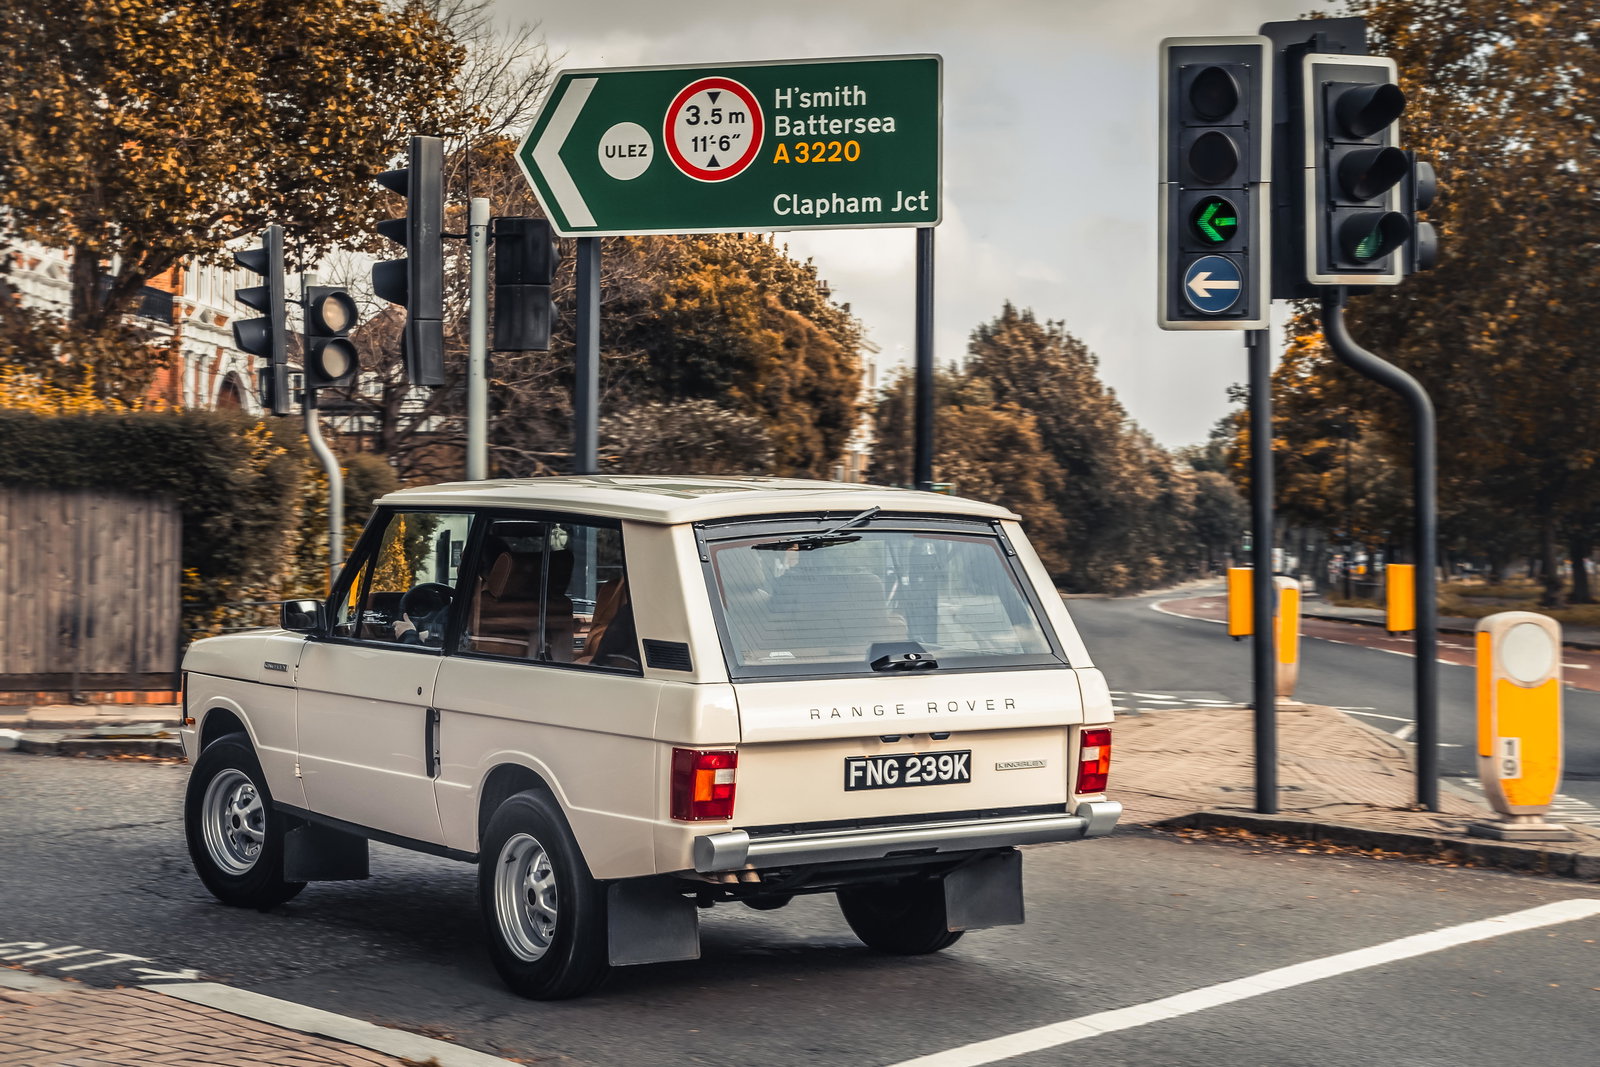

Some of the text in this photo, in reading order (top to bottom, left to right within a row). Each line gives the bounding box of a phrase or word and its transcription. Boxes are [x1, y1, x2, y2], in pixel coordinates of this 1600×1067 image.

[775, 85, 867, 109] H'smith
[685, 105, 746, 126] 3.5 m
[775, 114, 896, 137] Battersea
[605, 144, 648, 159] ULEZ
[773, 190, 929, 219] Clapham Jct
[810, 698, 1016, 720] RANGE ROVER
[849, 753, 969, 788] FNG 239K
